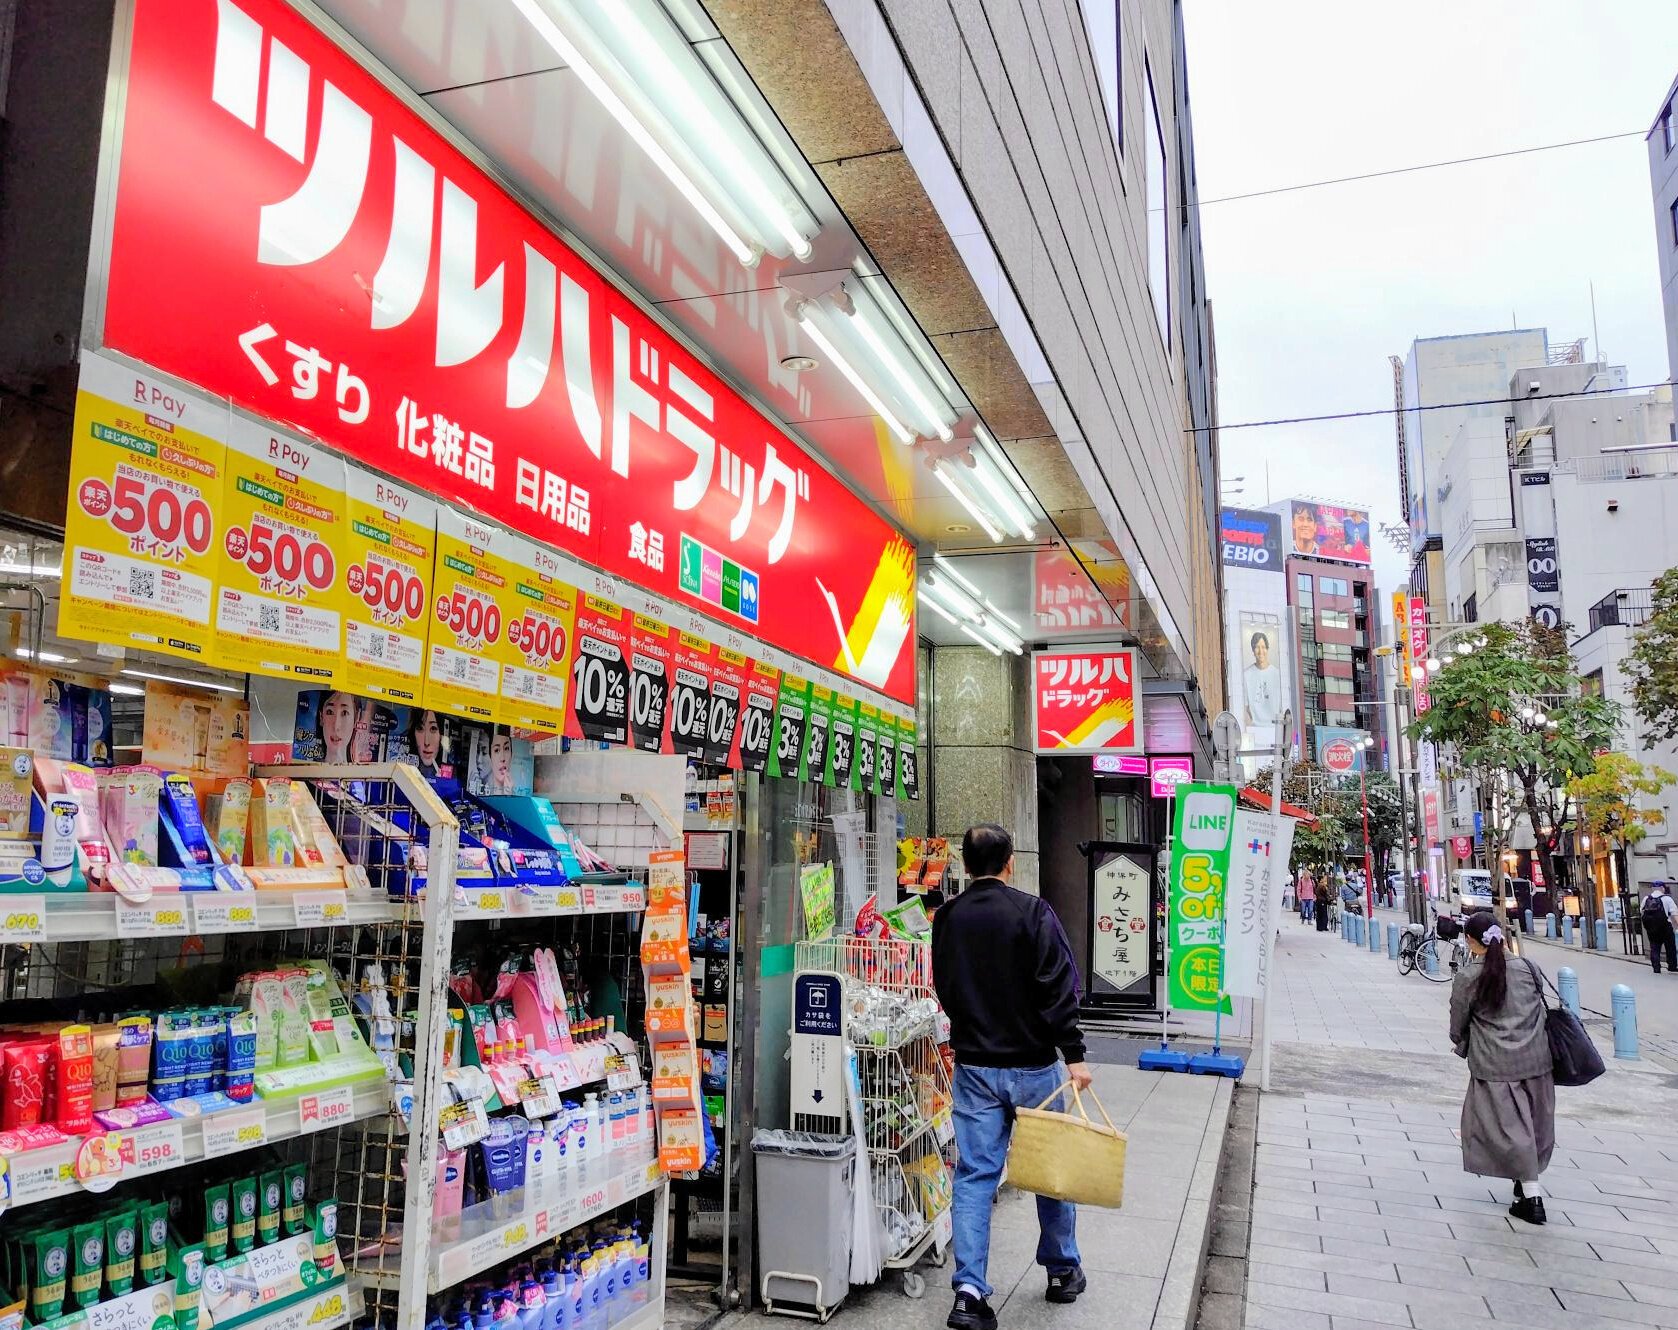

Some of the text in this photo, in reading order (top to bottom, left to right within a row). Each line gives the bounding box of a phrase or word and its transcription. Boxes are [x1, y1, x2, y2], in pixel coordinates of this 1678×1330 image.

[212, 0, 809, 564] ツルハドラッグ
[151, 387, 186, 418] Pay
[115, 418, 200, 455] 楽天ペイでのお支払いで
[238, 322, 665, 573] くすり 化粧品 日用品 食品
[282, 443, 310, 471] Pay
[118, 463, 200, 498] 当店のお買い物で使える
[83, 498, 108, 511] ポイント
[387, 489, 408, 512] Pay
[84, 476, 212, 552] 楽天 500
[254, 513, 319, 541] 当店のお買い物で使える
[474, 529, 492, 547] Pay
[131, 535, 185, 562] ポイント
[247, 523, 334, 589] 500
[543, 555, 559, 573] Pay
[260, 576, 306, 598] ポイント
[363, 561, 424, 619] 500
[372, 608, 404, 627] ポイント
[449, 592, 501, 643] 500
[1412, 607, 1425, 649] カラオケ
[456, 634, 483, 651] ポイント
[520, 615, 566, 661] 500
[526, 654, 550, 669] ポイント
[1041, 657, 1129, 685] ツルハ
[574, 655, 625, 714] 10%
[629, 671, 664, 726] 10%
[1042, 688, 1110, 708] ドラッグ
[670, 685, 707, 736] 10%
[707, 696, 737, 743] 10%
[740, 707, 771, 751] 10%
[778, 718, 799, 759] 3%
[807, 726, 824, 765] 3%
[832, 733, 850, 770] 3%
[1328, 751, 1352, 762] 消火栓
[1189, 814, 1226, 831] LINE
[622, 893, 641, 903] 950
[1241, 864, 1256, 935] プラスワン
[6, 913, 39, 929] 670
[655, 983, 680, 992] yuskin
[1191, 974, 1219, 992] 限定
[799, 1020, 838, 1029] ご利用ください
[805, 1011, 831, 1020] カサ袋を
[162, 1046, 187, 1063] Q10
[188, 1043, 214, 1060] Q10
[234, 1039, 255, 1055] Q10
[662, 1050, 686, 1060] yuskin
[67, 1063, 92, 1080] Q10
[323, 1103, 345, 1118] 880
[668, 1118, 693, 1129] yuskin
[141, 1143, 171, 1162] 598
[147, 1158, 162, 1168] 657
[666, 1156, 692, 1166] yuskin
[581, 1190, 603, 1208] 1600
[253, 1248, 285, 1268] さらっと
[92, 1301, 136, 1326] さらっと
[310, 1294, 342, 1324] 448
